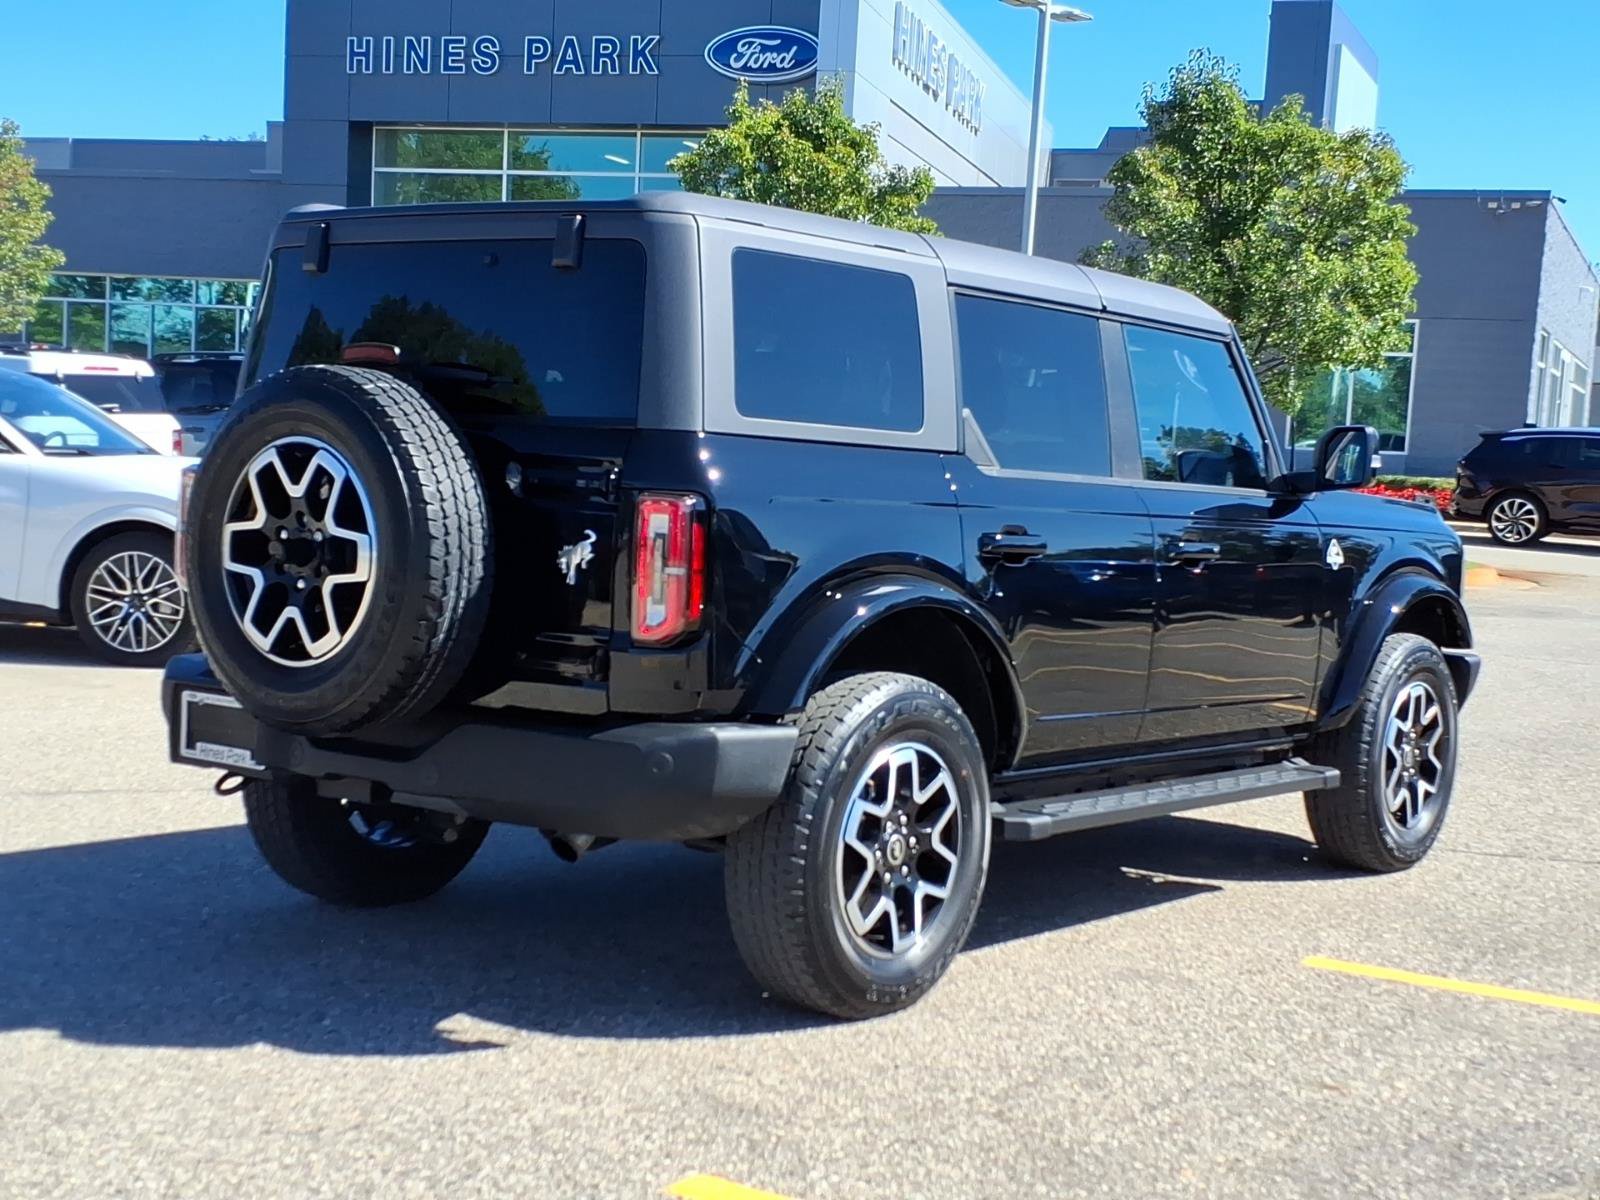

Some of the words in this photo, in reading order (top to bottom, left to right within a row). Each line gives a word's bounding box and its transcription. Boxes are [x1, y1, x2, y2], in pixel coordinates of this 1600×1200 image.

[346, 35, 500, 75] HINES
[523, 35, 660, 75] PARK
[729, 37, 798, 69] Ford
[892, 1, 946, 96] HINES
[945, 53, 985, 132] PARK
